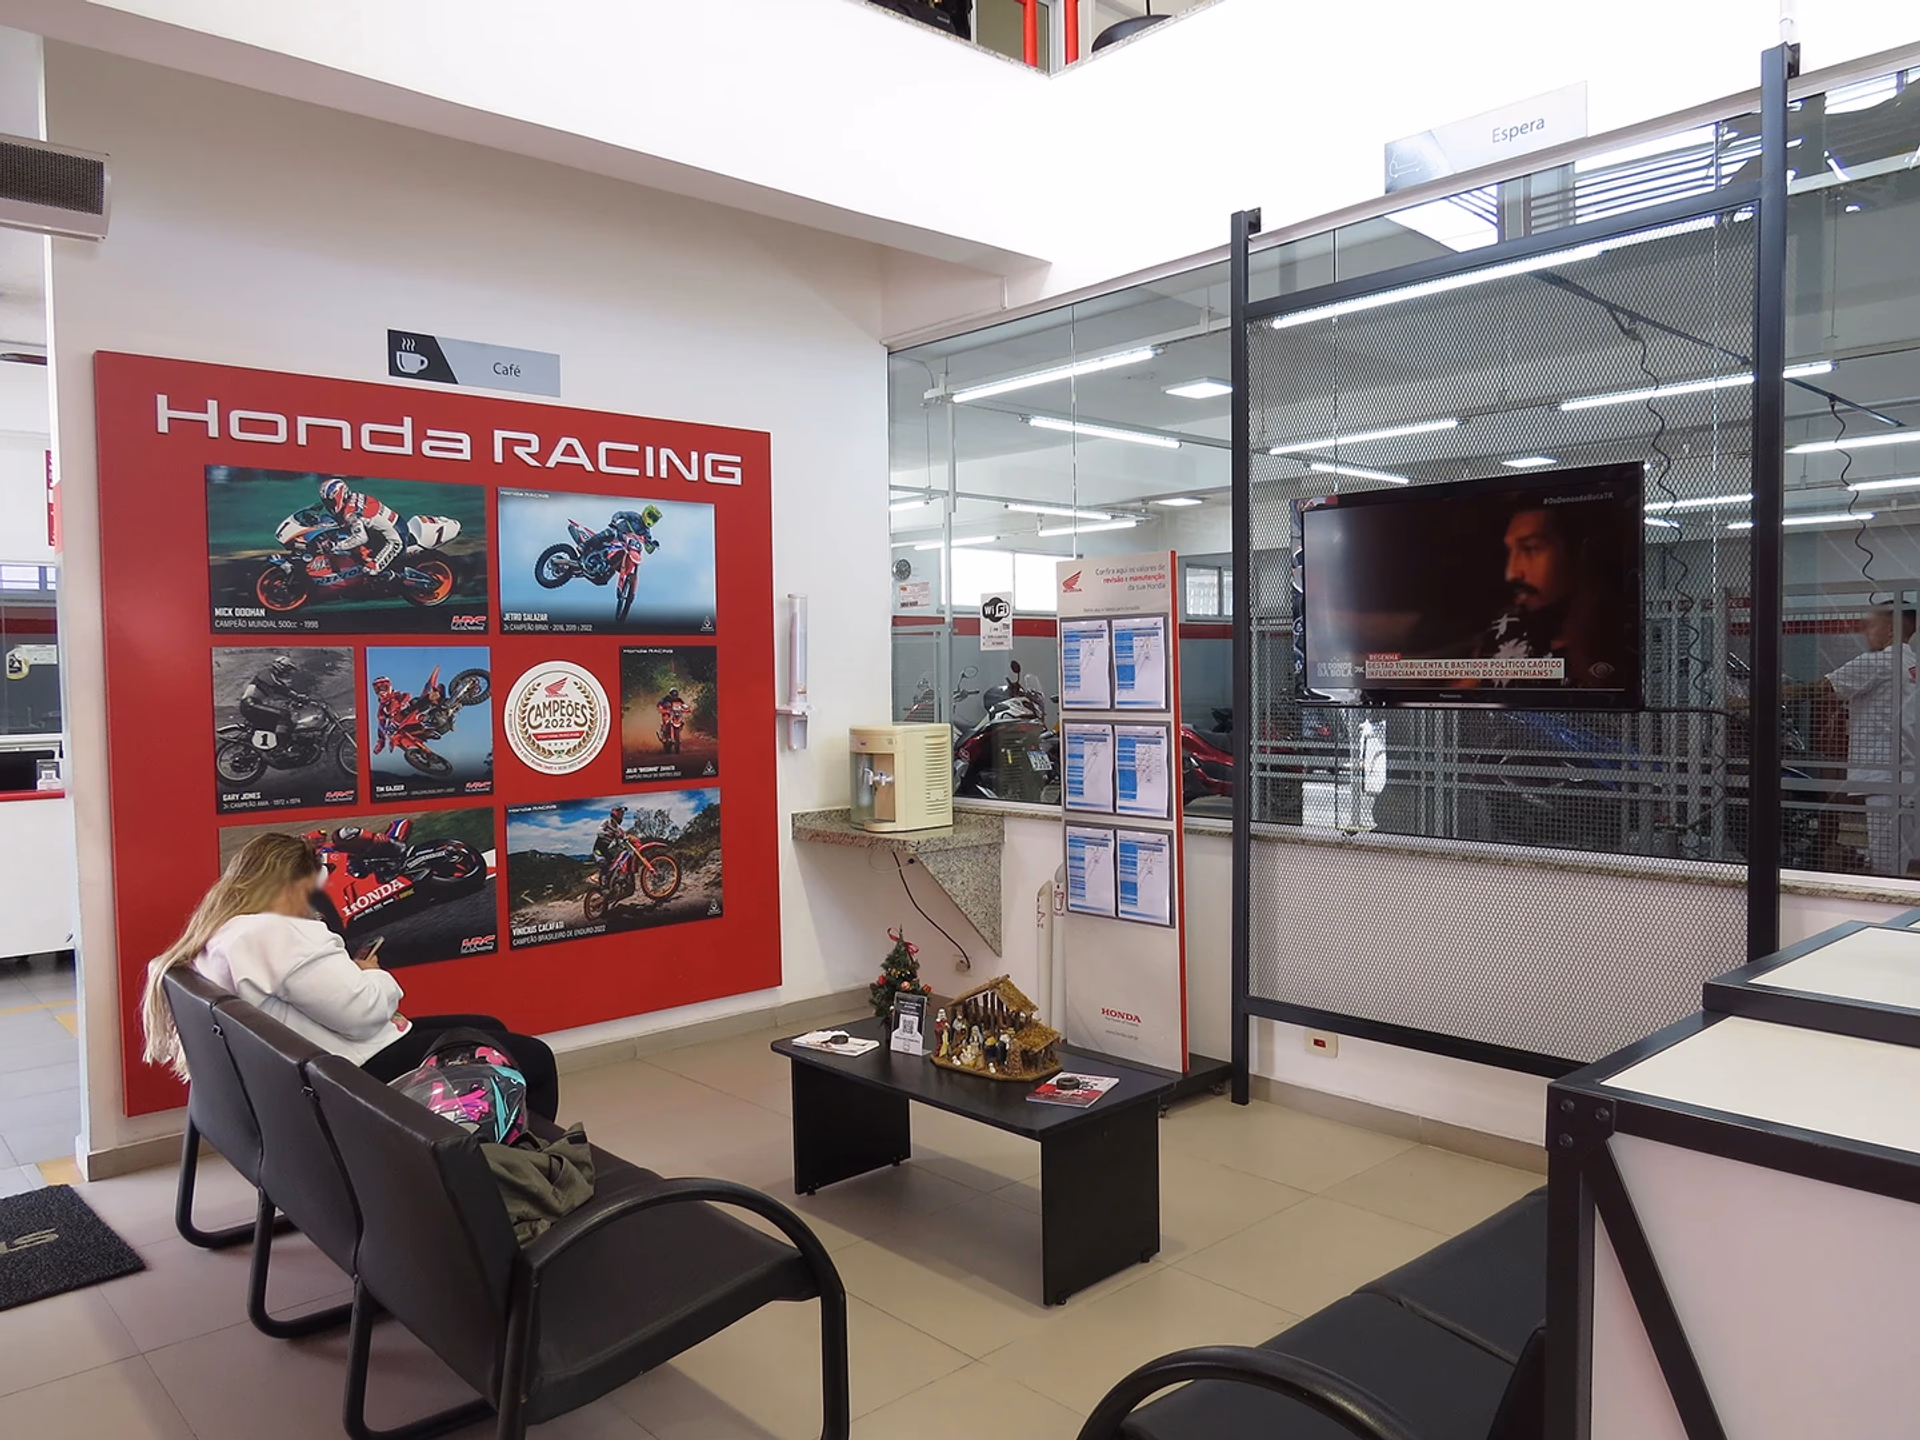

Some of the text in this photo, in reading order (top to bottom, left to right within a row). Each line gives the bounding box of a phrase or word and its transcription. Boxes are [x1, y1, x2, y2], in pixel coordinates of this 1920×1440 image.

[1491, 118, 1545, 143] Espera
[493, 362, 521, 377] Café
[157, 394, 742, 486] Honda RACING
[1095, 568, 1115, 576] Confira
[1116, 568, 1128, 576] aqui
[1136, 565, 1157, 573] valores
[1129, 573, 1166, 583] manutenção
[215, 607, 265, 617] MICK DOOHAN
[503, 613, 548, 622] JETRO SALAZAR
[215, 619, 247, 628] CAMPEÃO
[248, 620, 277, 628] MUNDIAL
[1367, 661, 1394, 669] GESTÃO
[1395, 661, 1443, 669] TURBULENTA
[1451, 661, 1489, 669] BASTIDOR
[1490, 660, 1526, 669] POLÍTICO
[1527, 660, 1562, 669] CAÓTICO
[1429, 669, 1481, 677] DESEMPENHO
[1482, 669, 1493, 677] DO
[1494, 669, 1553, 677] CORINTHIANS?
[527, 700, 588, 730] CAMPEÕES
[544, 718, 572, 729] 2022
[261, 734, 268, 747] 1
[223, 792, 261, 801] GARY JONES
[342, 878, 405, 917] HONDA
[512, 925, 537, 936] VINICIUS
[512, 935, 537, 947] CAMPEÃO
[538, 932, 566, 942] BRASILEIRO
[567, 930, 573, 938] DE
[574, 928, 593, 936] ENDURO
[1101, 1007, 1142, 1024] HONDA
